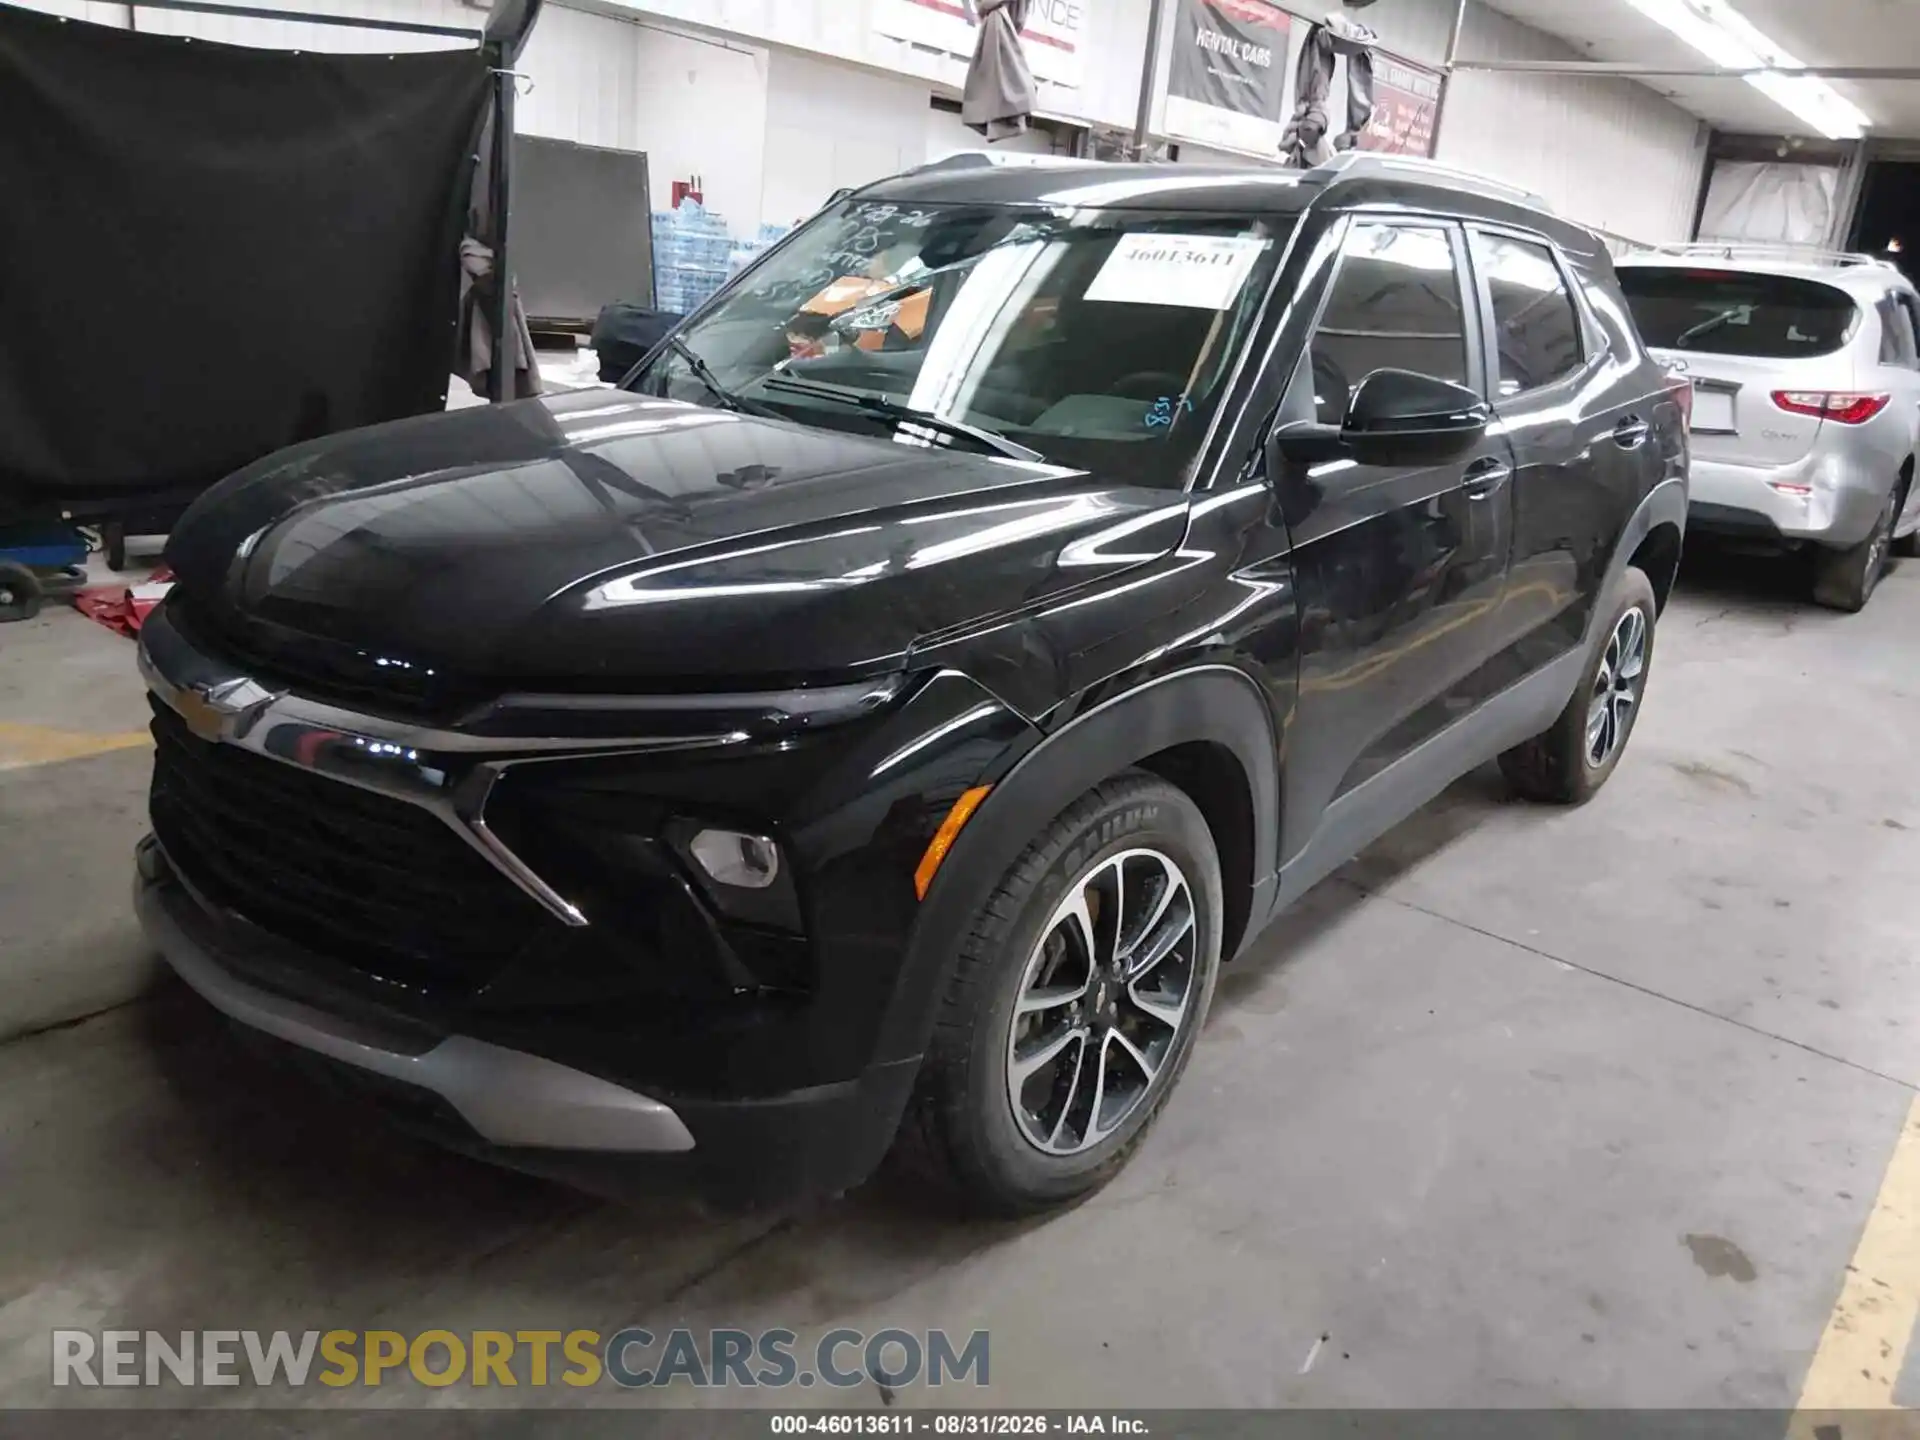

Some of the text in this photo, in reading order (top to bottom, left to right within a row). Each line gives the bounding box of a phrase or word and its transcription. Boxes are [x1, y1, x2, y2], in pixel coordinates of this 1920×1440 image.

[1195, 27, 1271, 68] RENTAL CARS
[1124, 248, 1236, 267] 46013611
